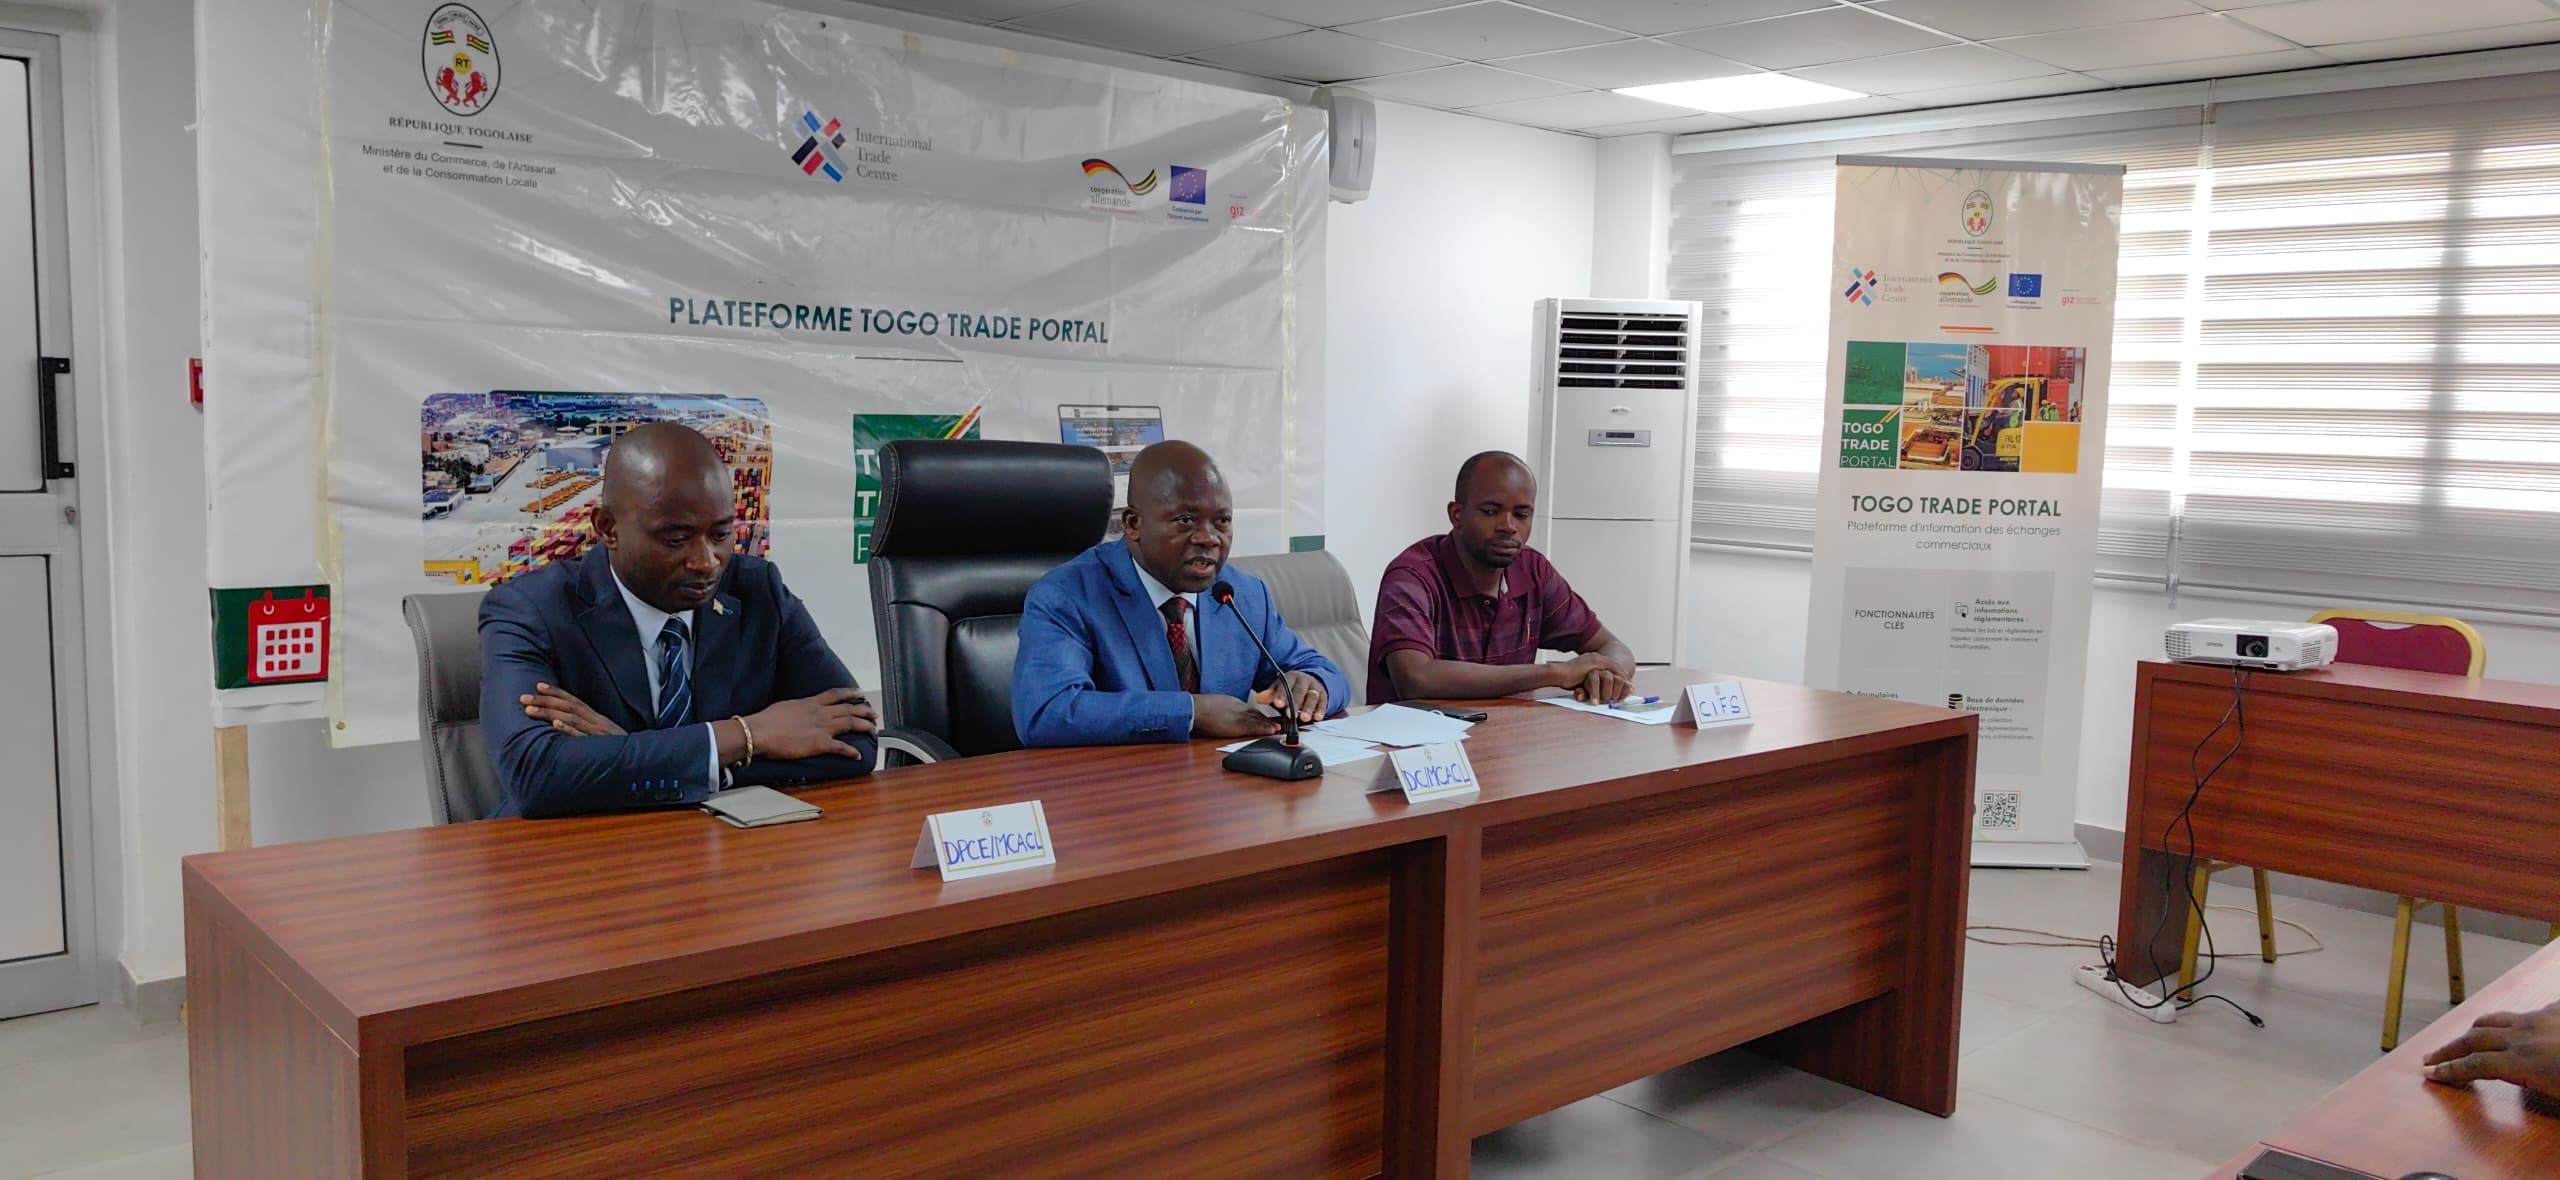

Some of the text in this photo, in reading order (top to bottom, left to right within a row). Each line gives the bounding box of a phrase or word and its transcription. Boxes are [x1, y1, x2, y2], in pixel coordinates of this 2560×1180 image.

[456, 58, 470, 68] RT
[389, 116, 534, 143] RÉPUBLIQUE TOGOLAISE
[856, 127, 932, 151] International
[362, 144, 556, 175] Ministère du Commerce, de l'Artisanat
[857, 147, 892, 165] Trade
[383, 164, 538, 188] et de la Consommation Locale
[856, 164, 899, 181] Centre
[1090, 192, 1132, 208] allemande
[1231, 206, 1244, 218] giz
[669, 297, 1109, 344] PLATEFORME TOGO TRADE PORTAL
[1843, 422, 1884, 434] TOGO
[1841, 438, 1890, 450] TRADE
[1841, 455, 1897, 468] PORTAL
[1851, 495, 2062, 517] TOGO TRADE PORTAL
[1847, 521, 2061, 538] Plateforme d'information des échanges
[1915, 540, 1992, 551] commerciaux
[1854, 609, 1935, 620] FONCTIONNALITÉS
[1883, 620, 1905, 630] CLÉS
[944, 832, 1043, 865] DPCE/MCACL
